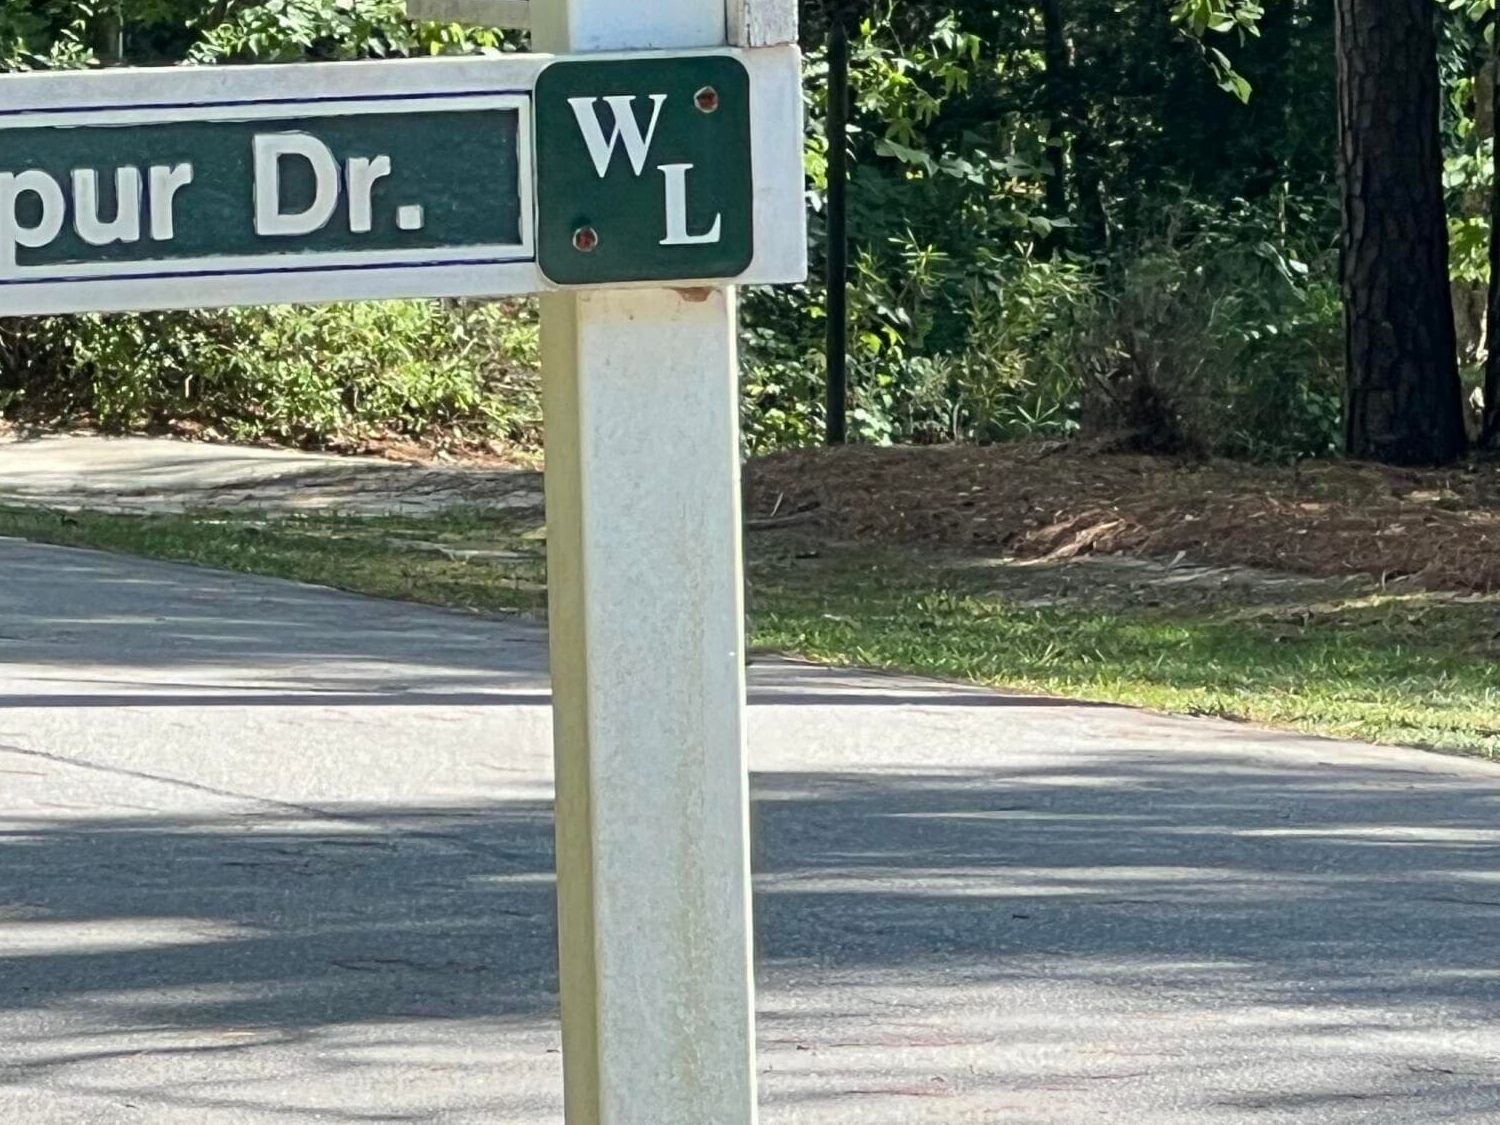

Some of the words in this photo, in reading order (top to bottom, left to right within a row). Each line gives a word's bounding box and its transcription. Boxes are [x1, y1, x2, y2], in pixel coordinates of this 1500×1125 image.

[567, 94, 667, 178] W
[252, 131, 424, 236] Dr.
[657, 163, 721, 245] L
